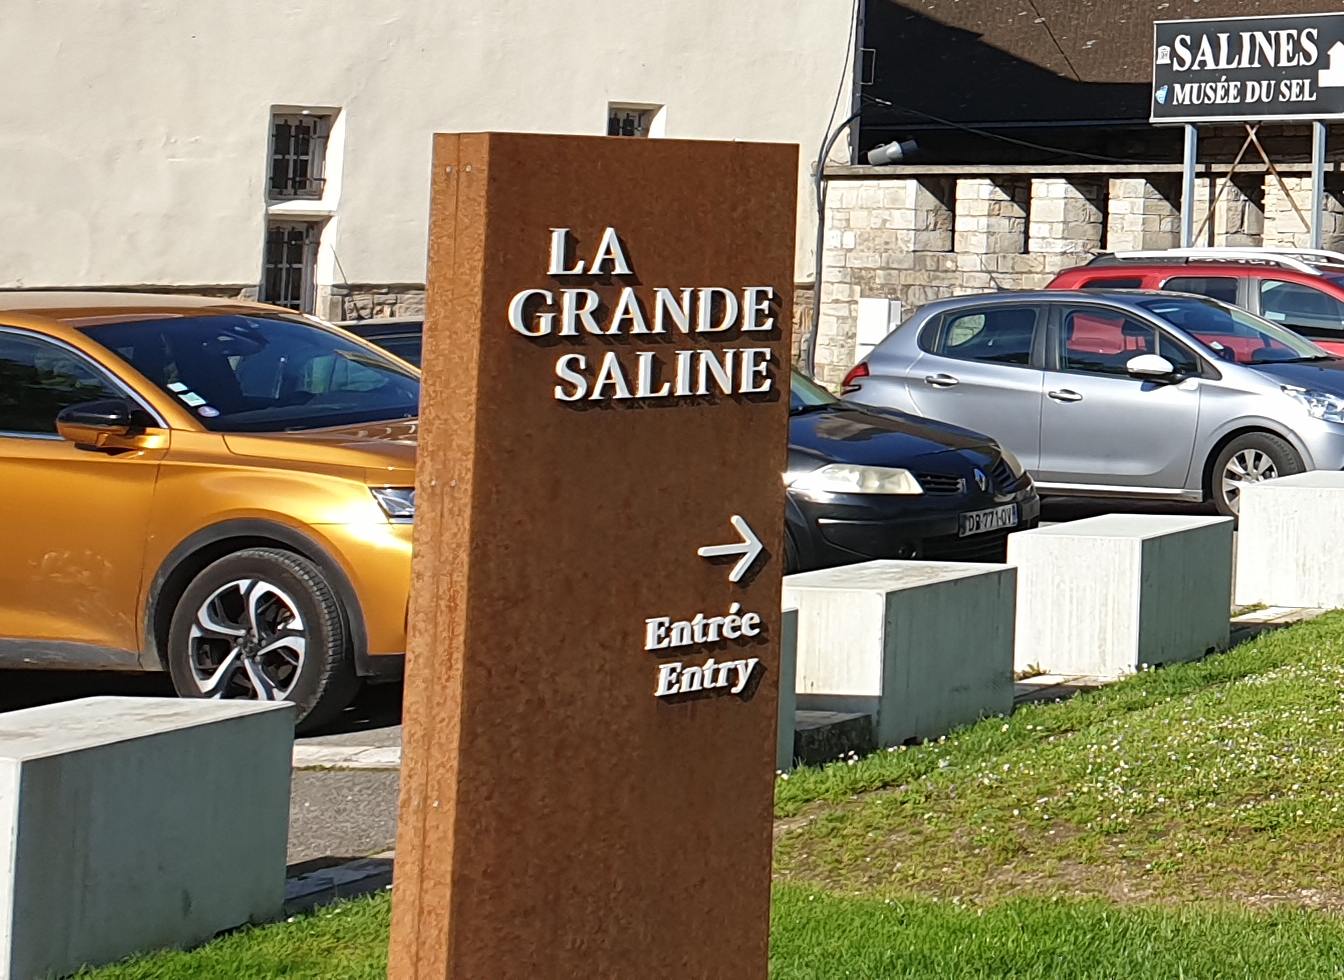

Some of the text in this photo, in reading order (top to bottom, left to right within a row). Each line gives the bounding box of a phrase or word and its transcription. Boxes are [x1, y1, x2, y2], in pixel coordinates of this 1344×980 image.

[1173, 28, 1318, 71] SALINES
[1172, 75, 1317, 105] MUSÉE DU SEL
[548, 226, 633, 275] LA
[508, 286, 774, 337] GRANDE
[554, 347, 772, 402] SALINE
[645, 602, 761, 650] Entrée
[654, 657, 759, 697] Entry
